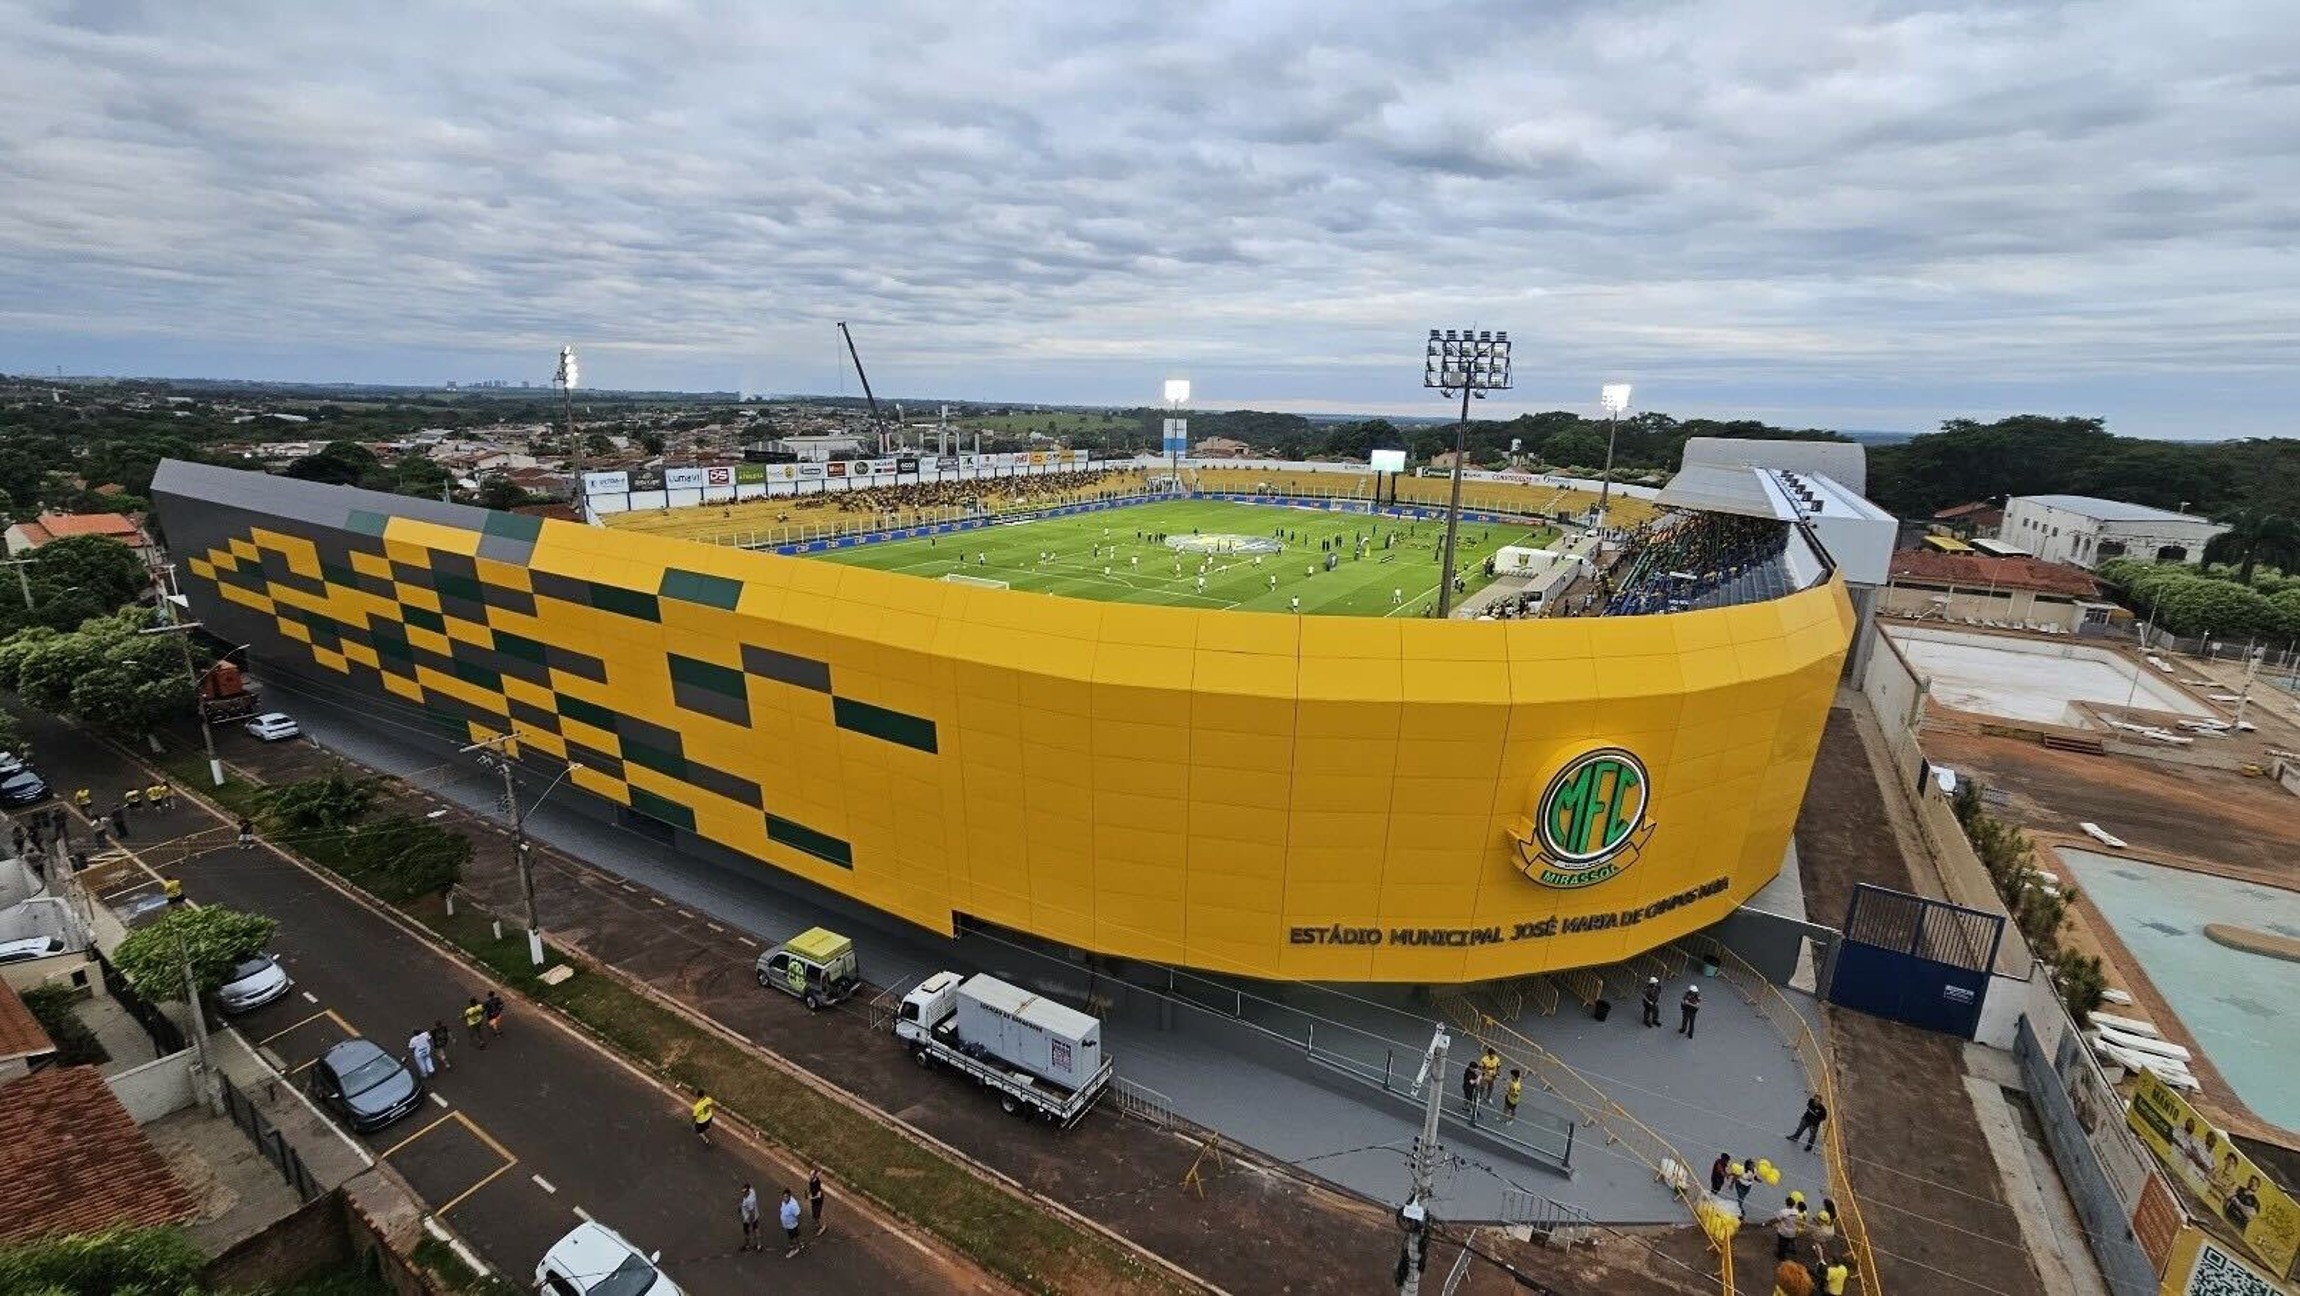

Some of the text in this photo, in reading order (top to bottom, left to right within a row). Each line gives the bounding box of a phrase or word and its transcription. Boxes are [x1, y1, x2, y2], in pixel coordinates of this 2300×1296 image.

[1548, 760, 1641, 856] MFC
[1289, 923, 1383, 946] ESTÁDIO
[1389, 926, 1505, 947] MUNICIPAL
[1510, 914, 1559, 941] JOSÉ
[1561, 912, 1619, 935] MARIA
[1619, 908, 1645, 927] DE
